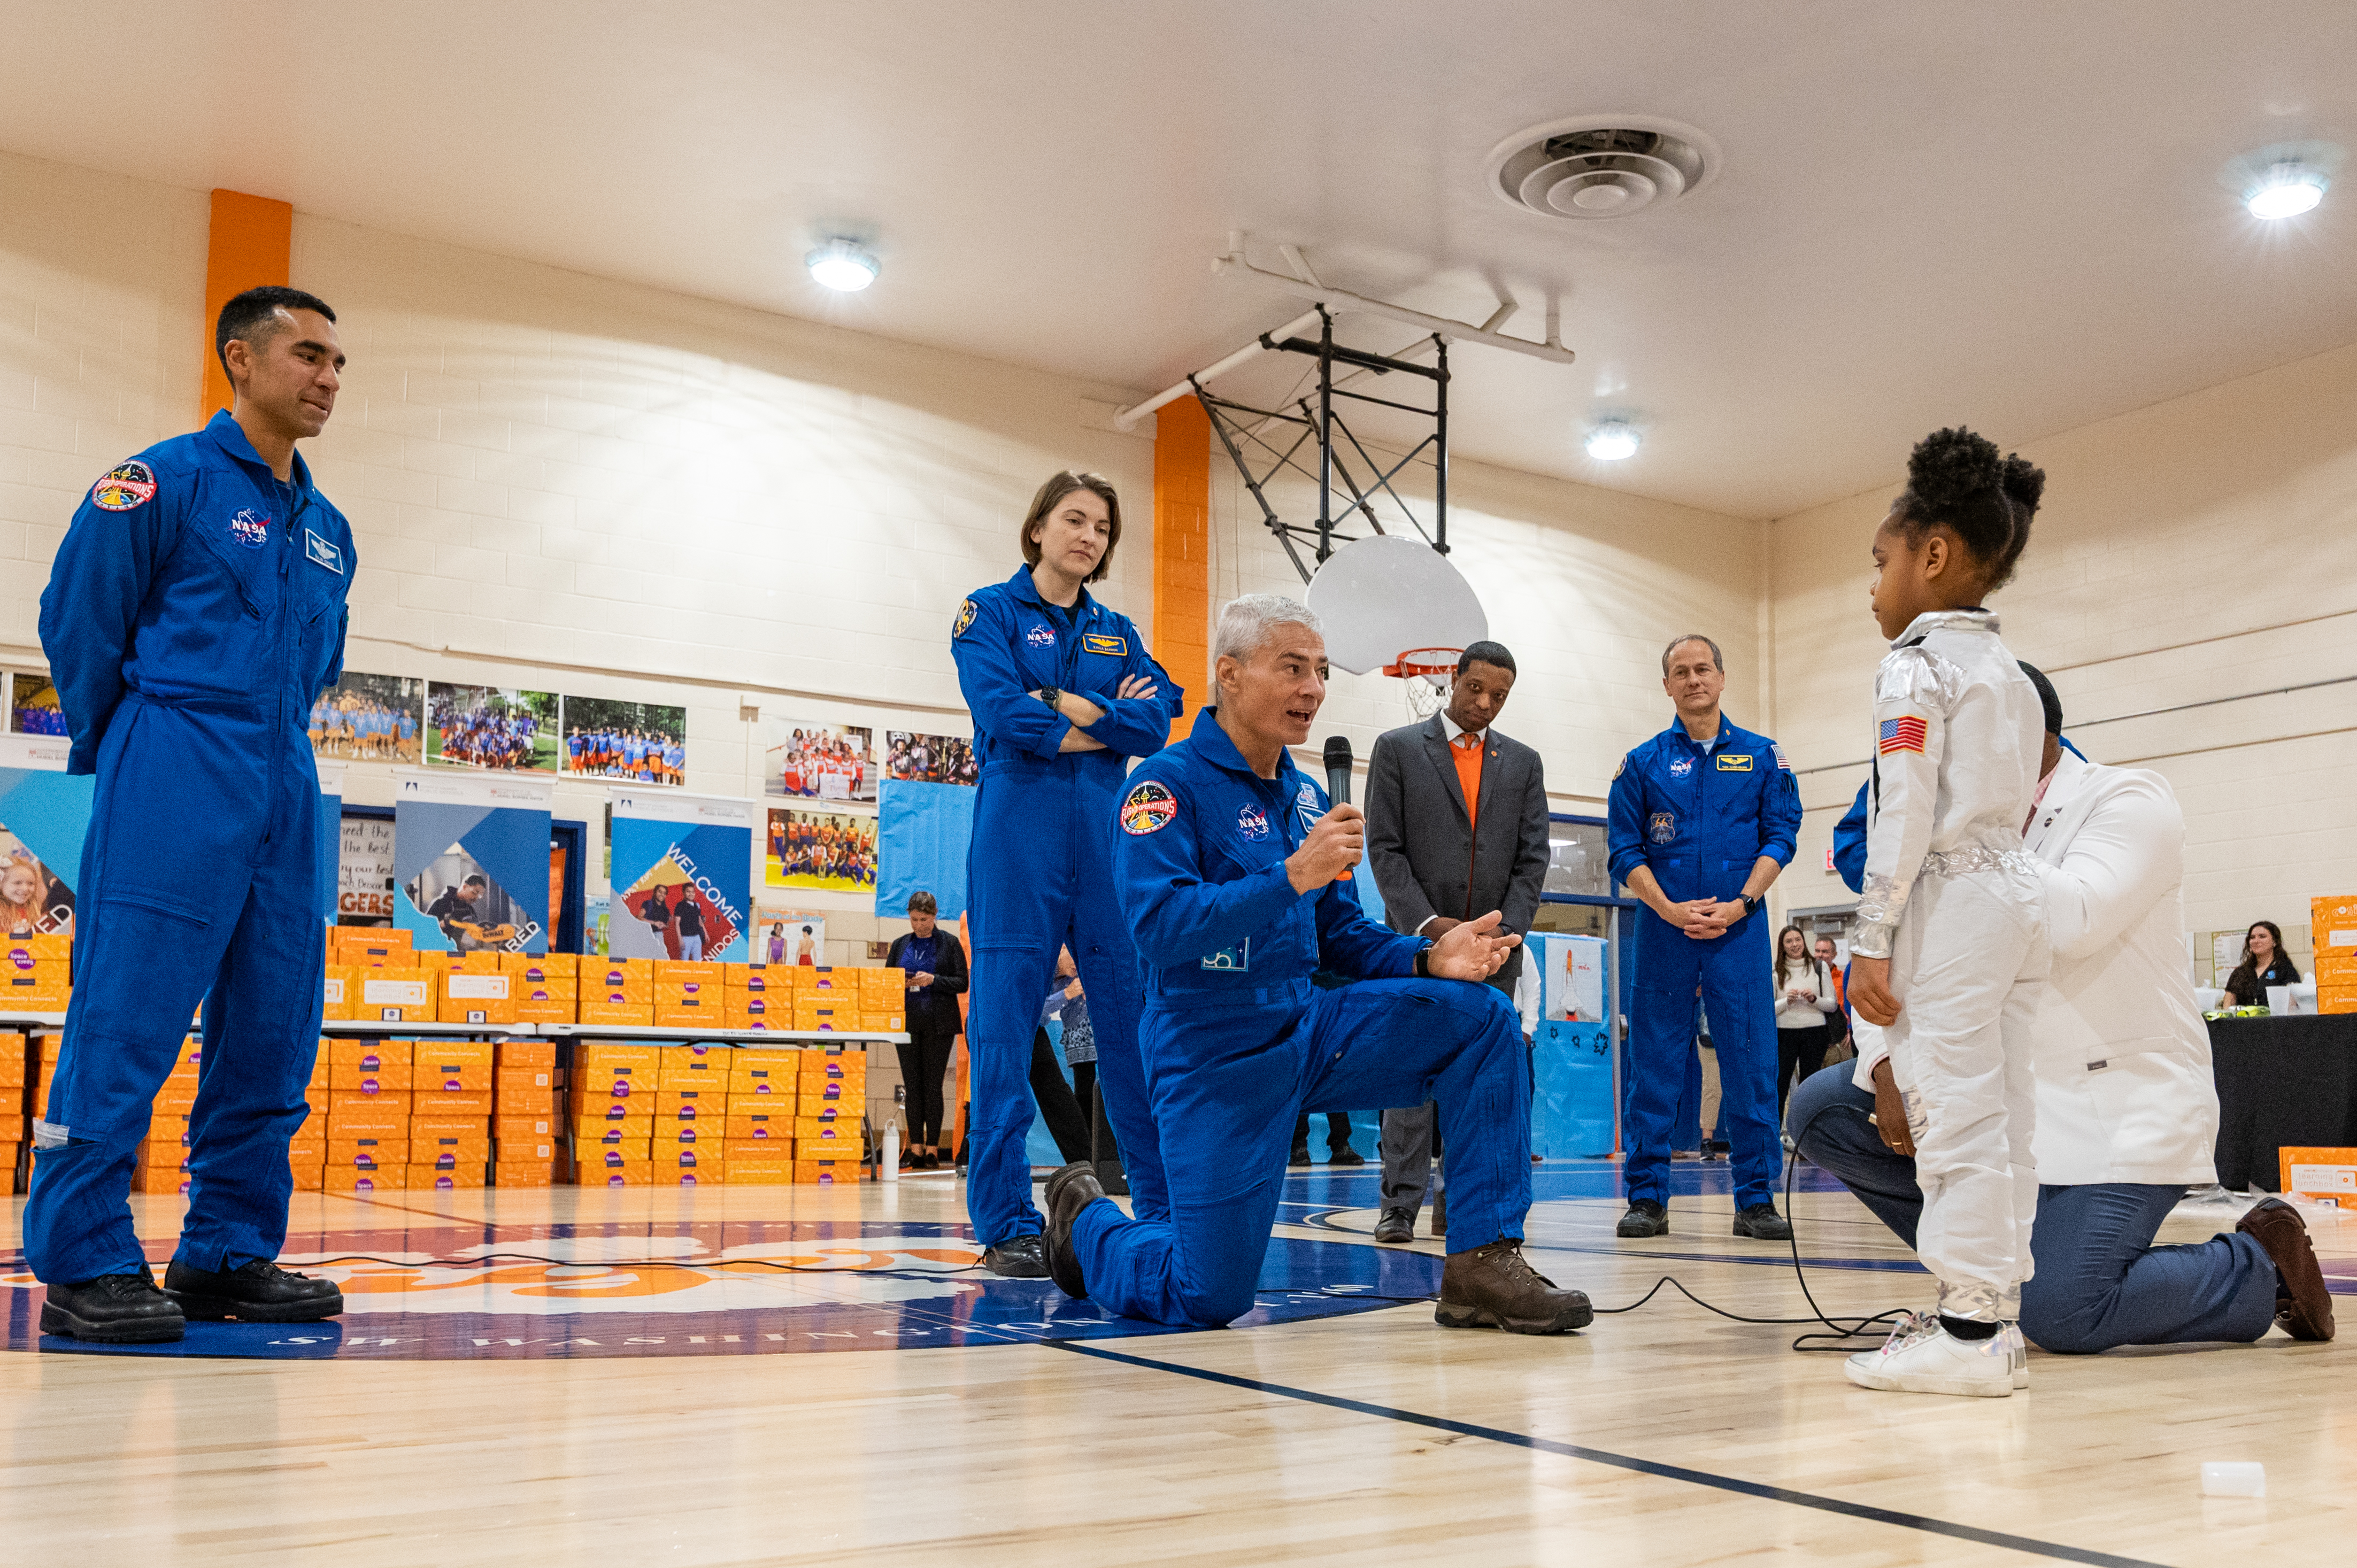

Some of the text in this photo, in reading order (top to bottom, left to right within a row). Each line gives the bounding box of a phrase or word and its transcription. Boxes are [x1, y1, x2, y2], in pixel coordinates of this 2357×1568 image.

[114, 480, 154, 498] OPERATIONS
[232, 519, 267, 536] NASA
[1670, 763, 1692, 771] NASA
[1121, 800, 1175, 822] FLIGHT OPERATIONS
[1238, 817, 1268, 829] NASA
[344, 840, 361, 853] the
[666, 841, 743, 927] WELCOME
[266, 1318, 1115, 1347] SW WASHINGTON
